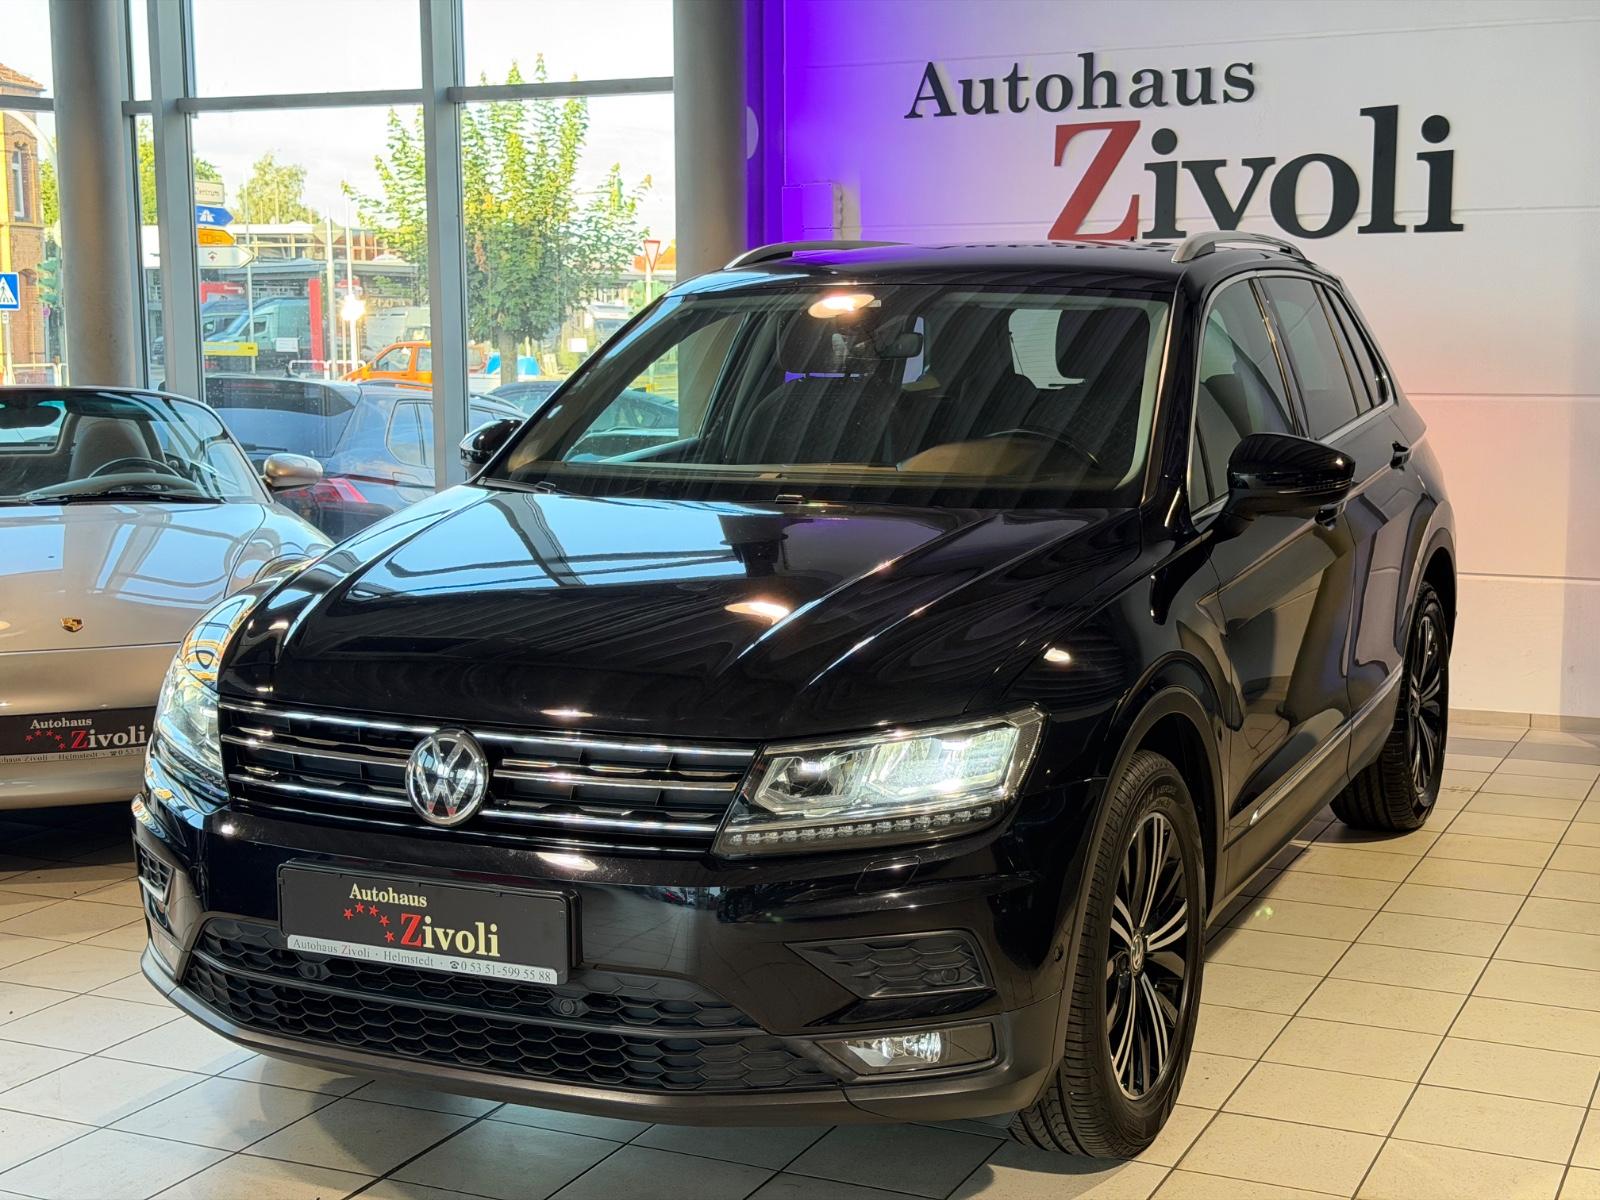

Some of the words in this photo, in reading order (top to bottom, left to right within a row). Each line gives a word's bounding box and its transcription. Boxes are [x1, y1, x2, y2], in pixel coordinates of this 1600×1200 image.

[904, 53, 1256, 119] Autohaus
[1047, 104, 1464, 241] Zivoli
[30, 717, 93, 730] Autohaus
[71, 725, 147, 749] Zivoli
[350, 883, 428, 908] Autohaus
[401, 913, 500, 957] Zivoli
[293, 939, 338, 953] Autohaus
[341, 944, 371, 959] Zivoli
[383, 950, 434, 968] Helmstedt
